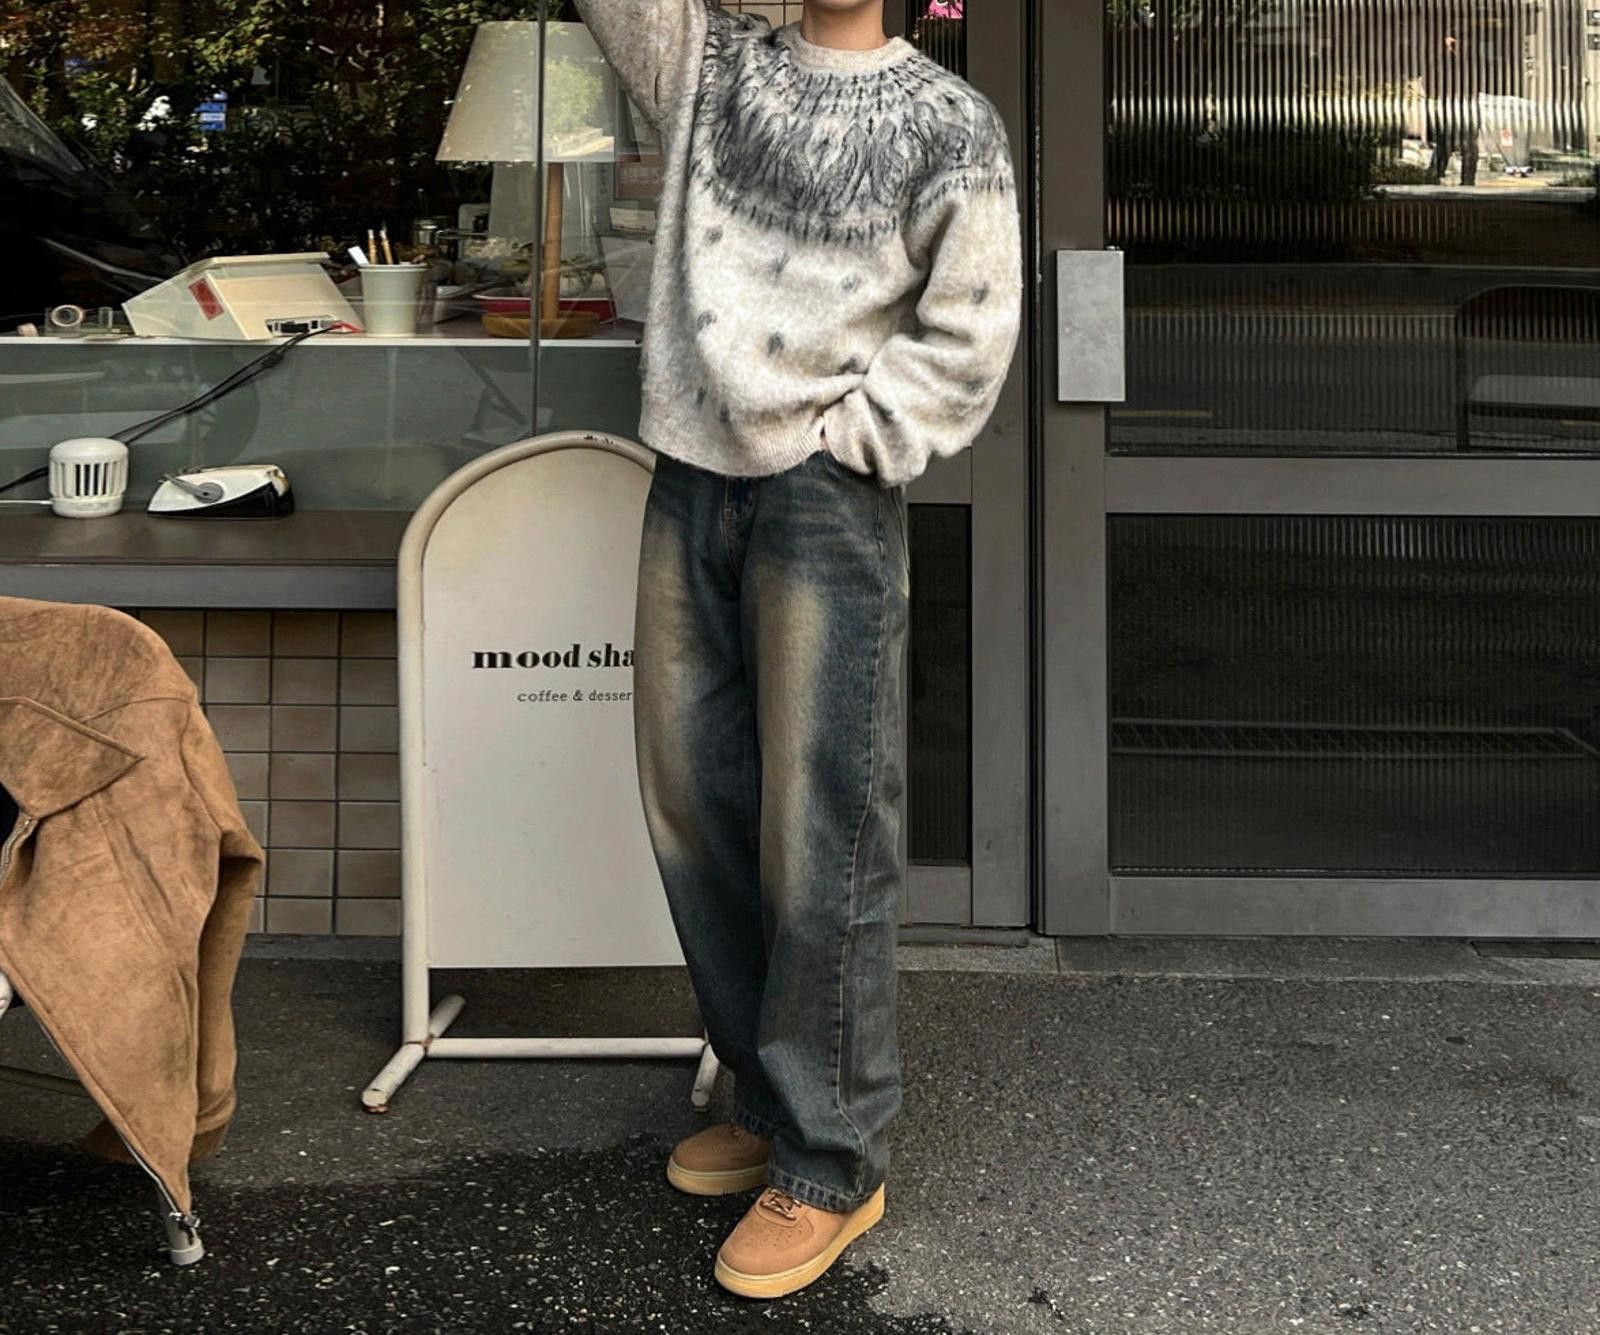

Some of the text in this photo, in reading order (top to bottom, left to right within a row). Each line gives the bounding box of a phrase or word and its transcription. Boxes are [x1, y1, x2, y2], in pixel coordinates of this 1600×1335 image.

[472, 643, 581, 669] mood
[516, 689, 569, 702] coffee
[572, 689, 584, 702] &
